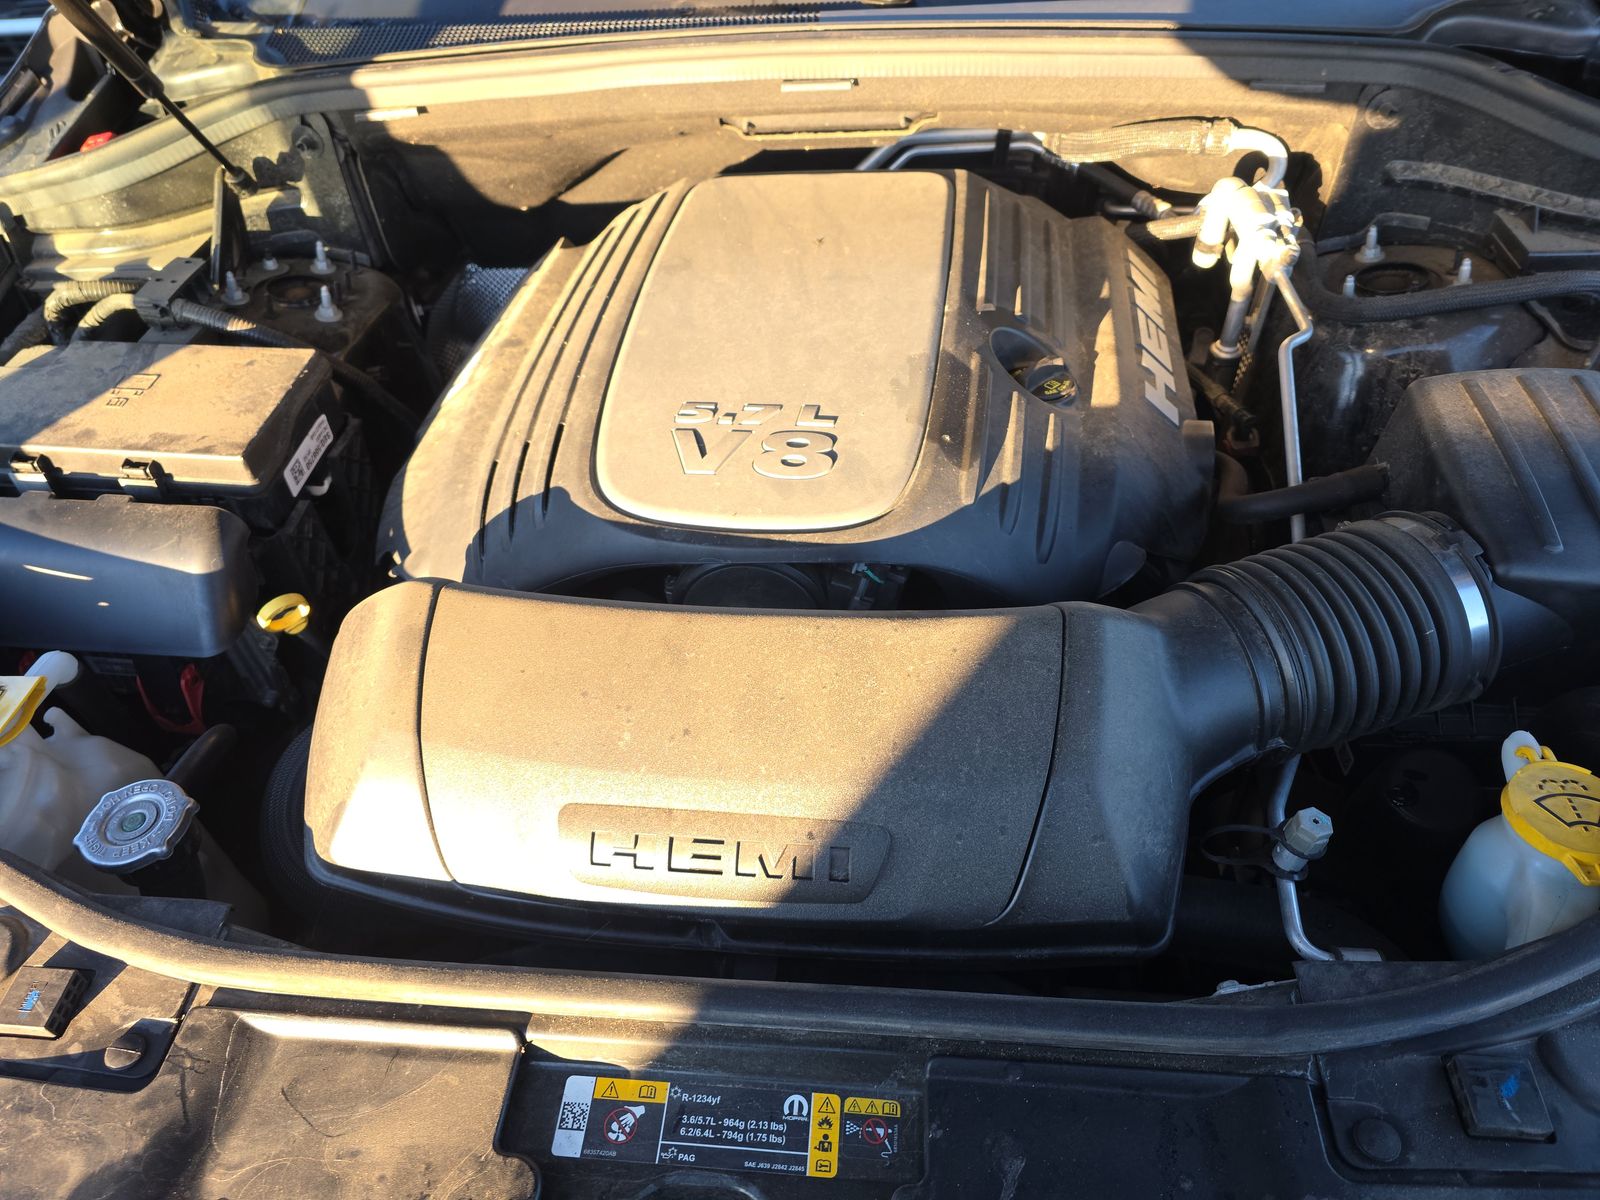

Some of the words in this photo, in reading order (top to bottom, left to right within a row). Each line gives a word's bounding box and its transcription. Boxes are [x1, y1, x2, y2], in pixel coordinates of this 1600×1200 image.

[1127, 249, 1180, 427] HEMI
[671, 427, 838, 480] V8
[112, 838, 151, 858] KEEP
[589, 830, 851, 884] HEMI
[681, 1093, 721, 1105] R-1234yf
[681, 1114, 716, 1126] 3.6/5.7L
[723, 1118, 745, 1130] 964g
[747, 1120, 768, 1131] (2.13
[770, 1122, 787, 1133] lbs)
[680, 1127, 714, 1139] 6.2/6.4L
[722, 1130, 743, 1142] 794g
[745, 1132, 767, 1143] (1.75
[769, 1134, 786, 1146] lbs)
[678, 1153, 696, 1162] PAG
